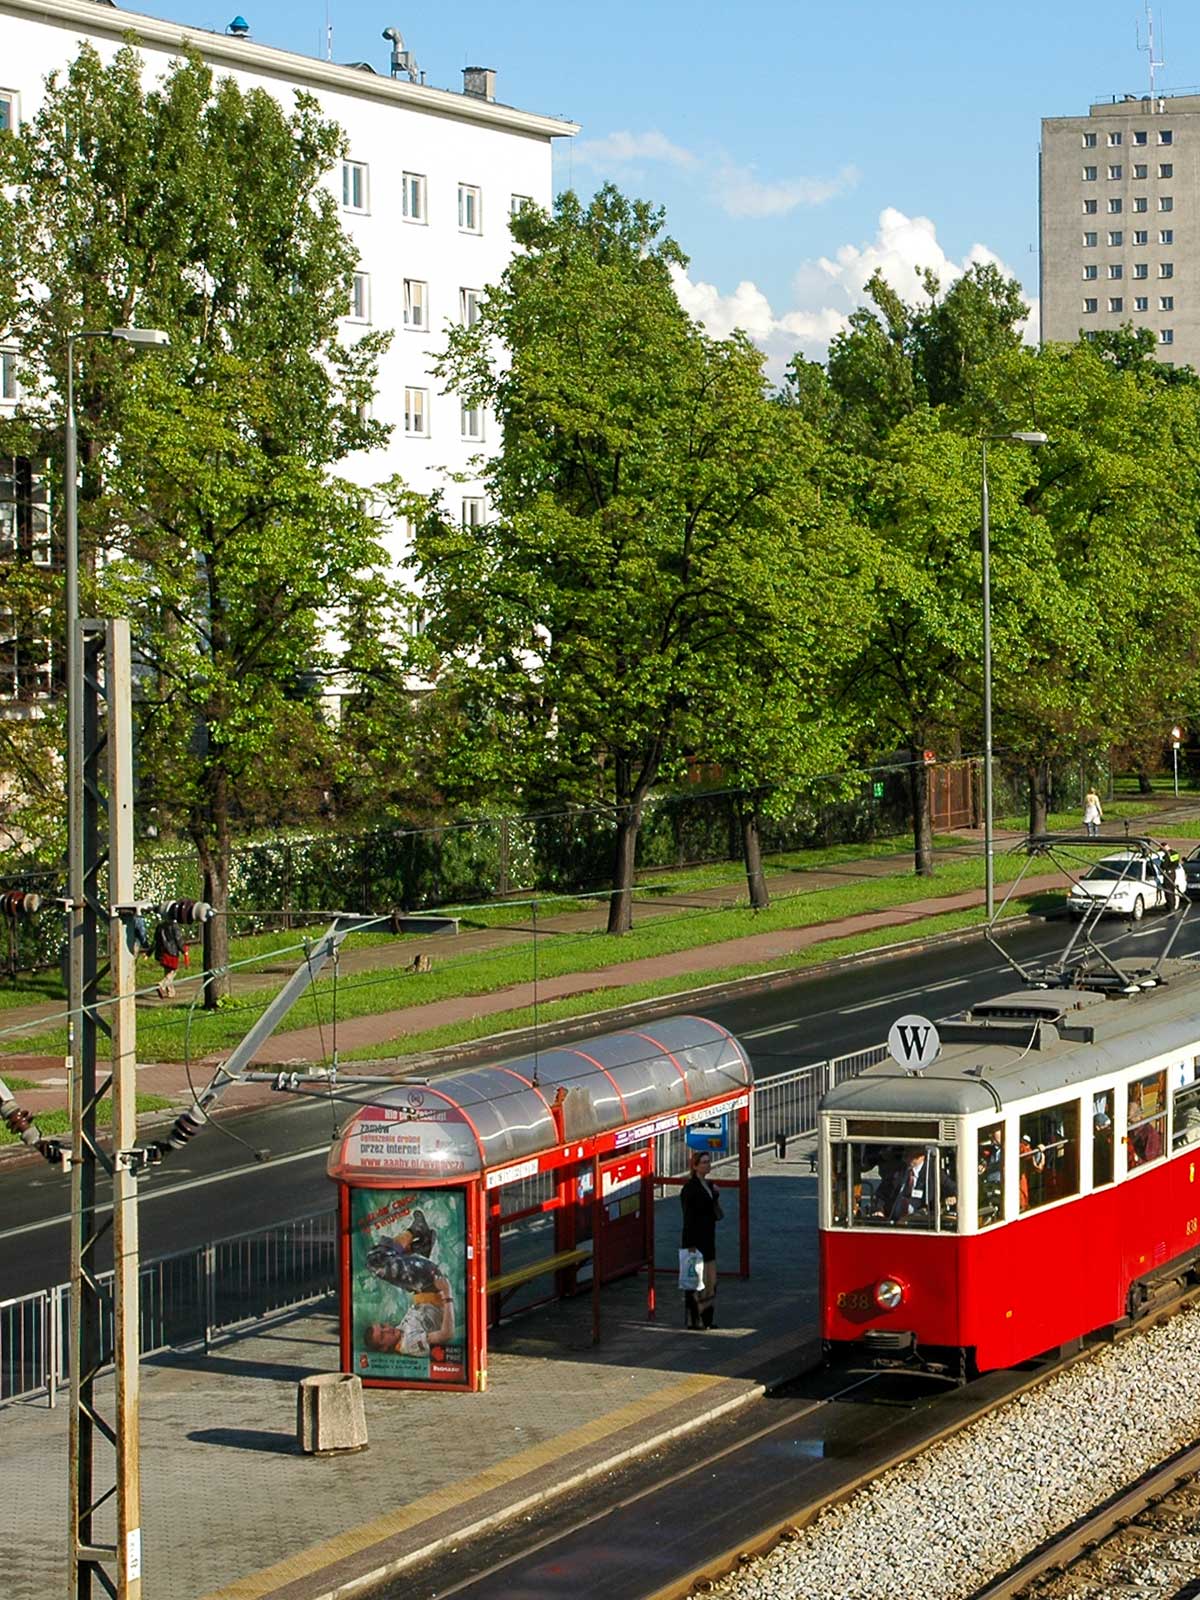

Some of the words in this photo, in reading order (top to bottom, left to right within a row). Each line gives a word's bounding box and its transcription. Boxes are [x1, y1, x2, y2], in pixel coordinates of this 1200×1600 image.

[896, 1025, 931, 1061] W
[360, 1144, 384, 1154] przez
[386, 1143, 421, 1154] internet
[1186, 1217, 1198, 1236] 838
[837, 1291, 869, 1309] 838
